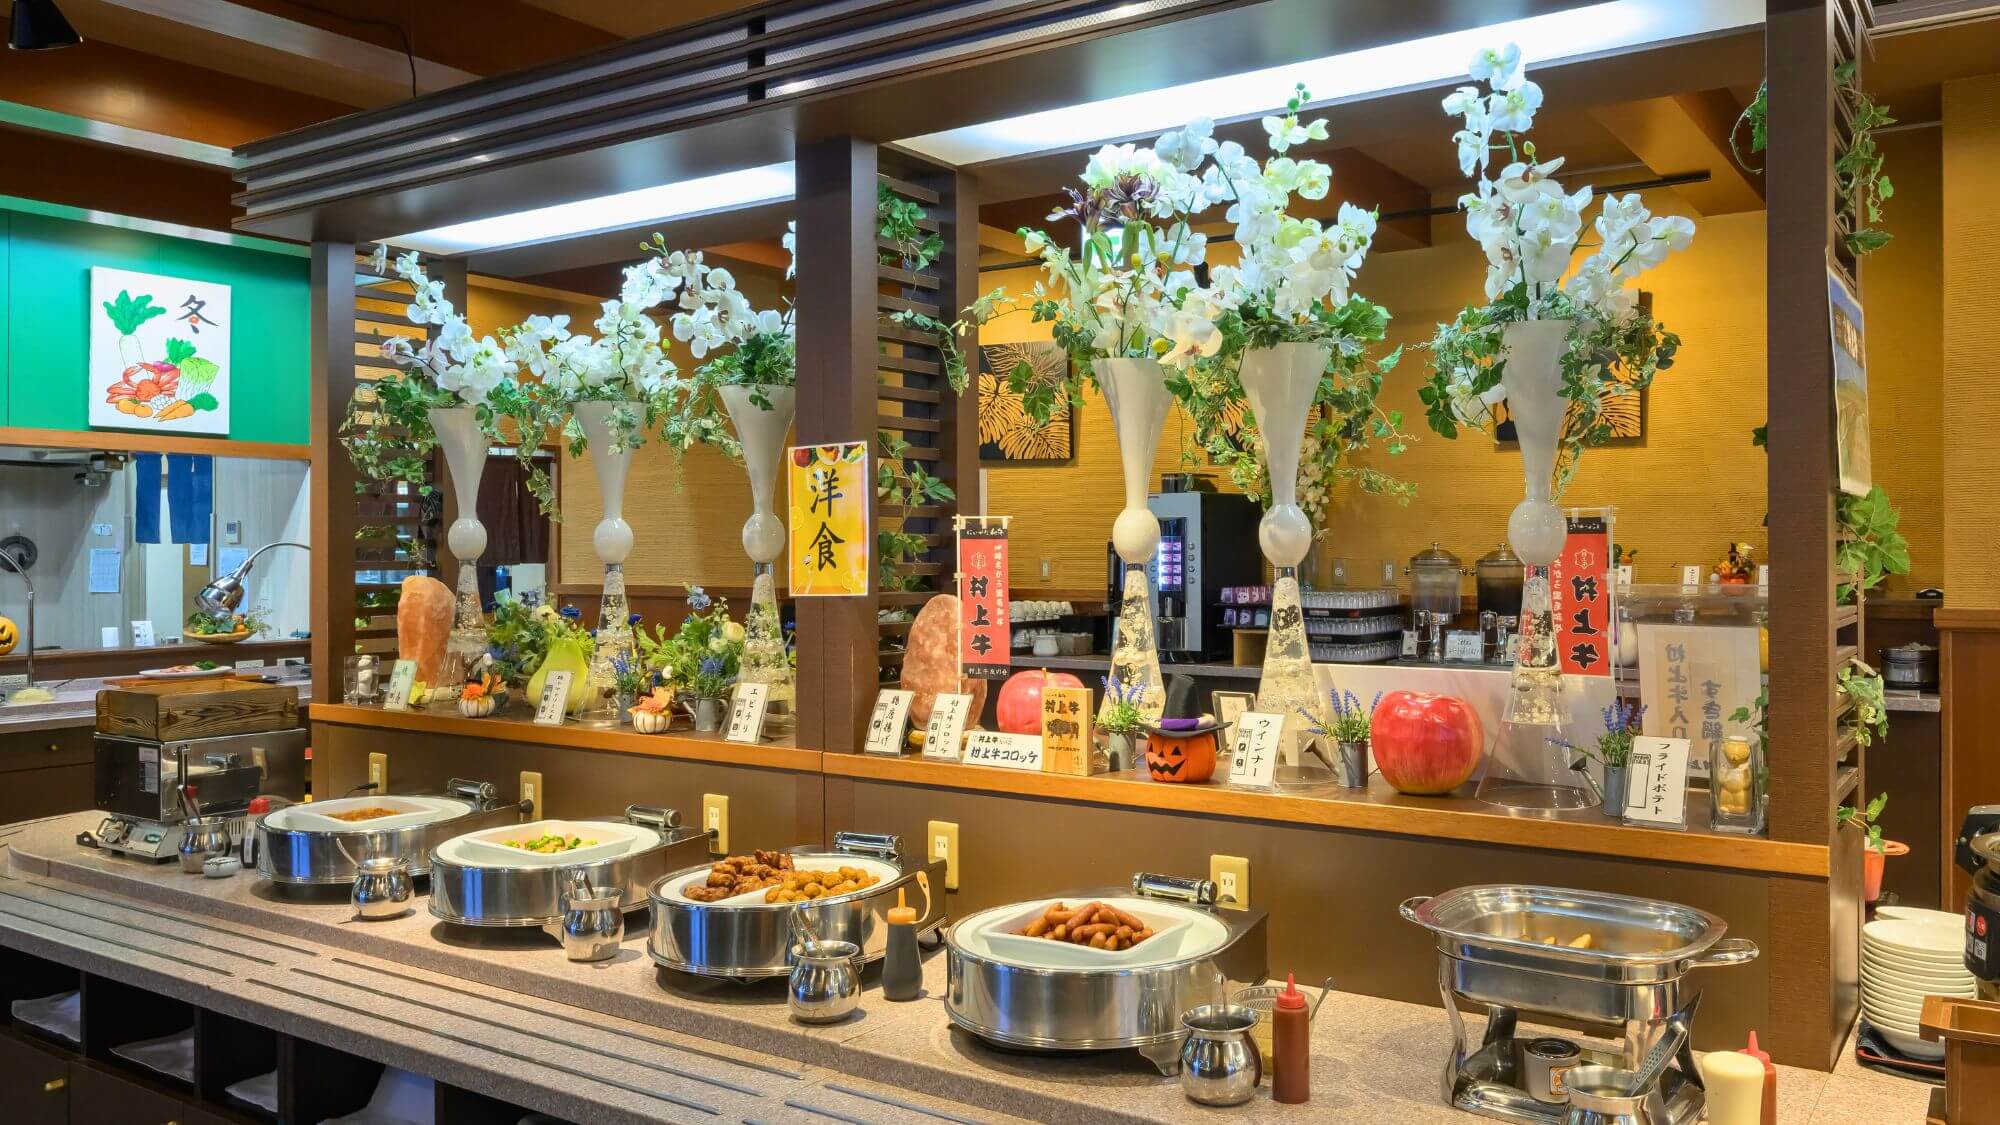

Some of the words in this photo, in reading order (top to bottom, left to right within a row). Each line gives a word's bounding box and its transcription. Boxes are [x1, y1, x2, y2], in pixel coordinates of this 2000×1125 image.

[176, 294, 219, 334] 冬
[809, 468, 845, 572] 洋食
[969, 575, 993, 656] 村上牛
[743, 688, 758, 733] エビチリ
[941, 699, 960, 754] 村上牛コロッケ
[1044, 699, 1081, 716] 村上牛
[970, 746, 1039, 765] 村上牛コロッケ
[1653, 743, 1671, 815] フライドポテト
